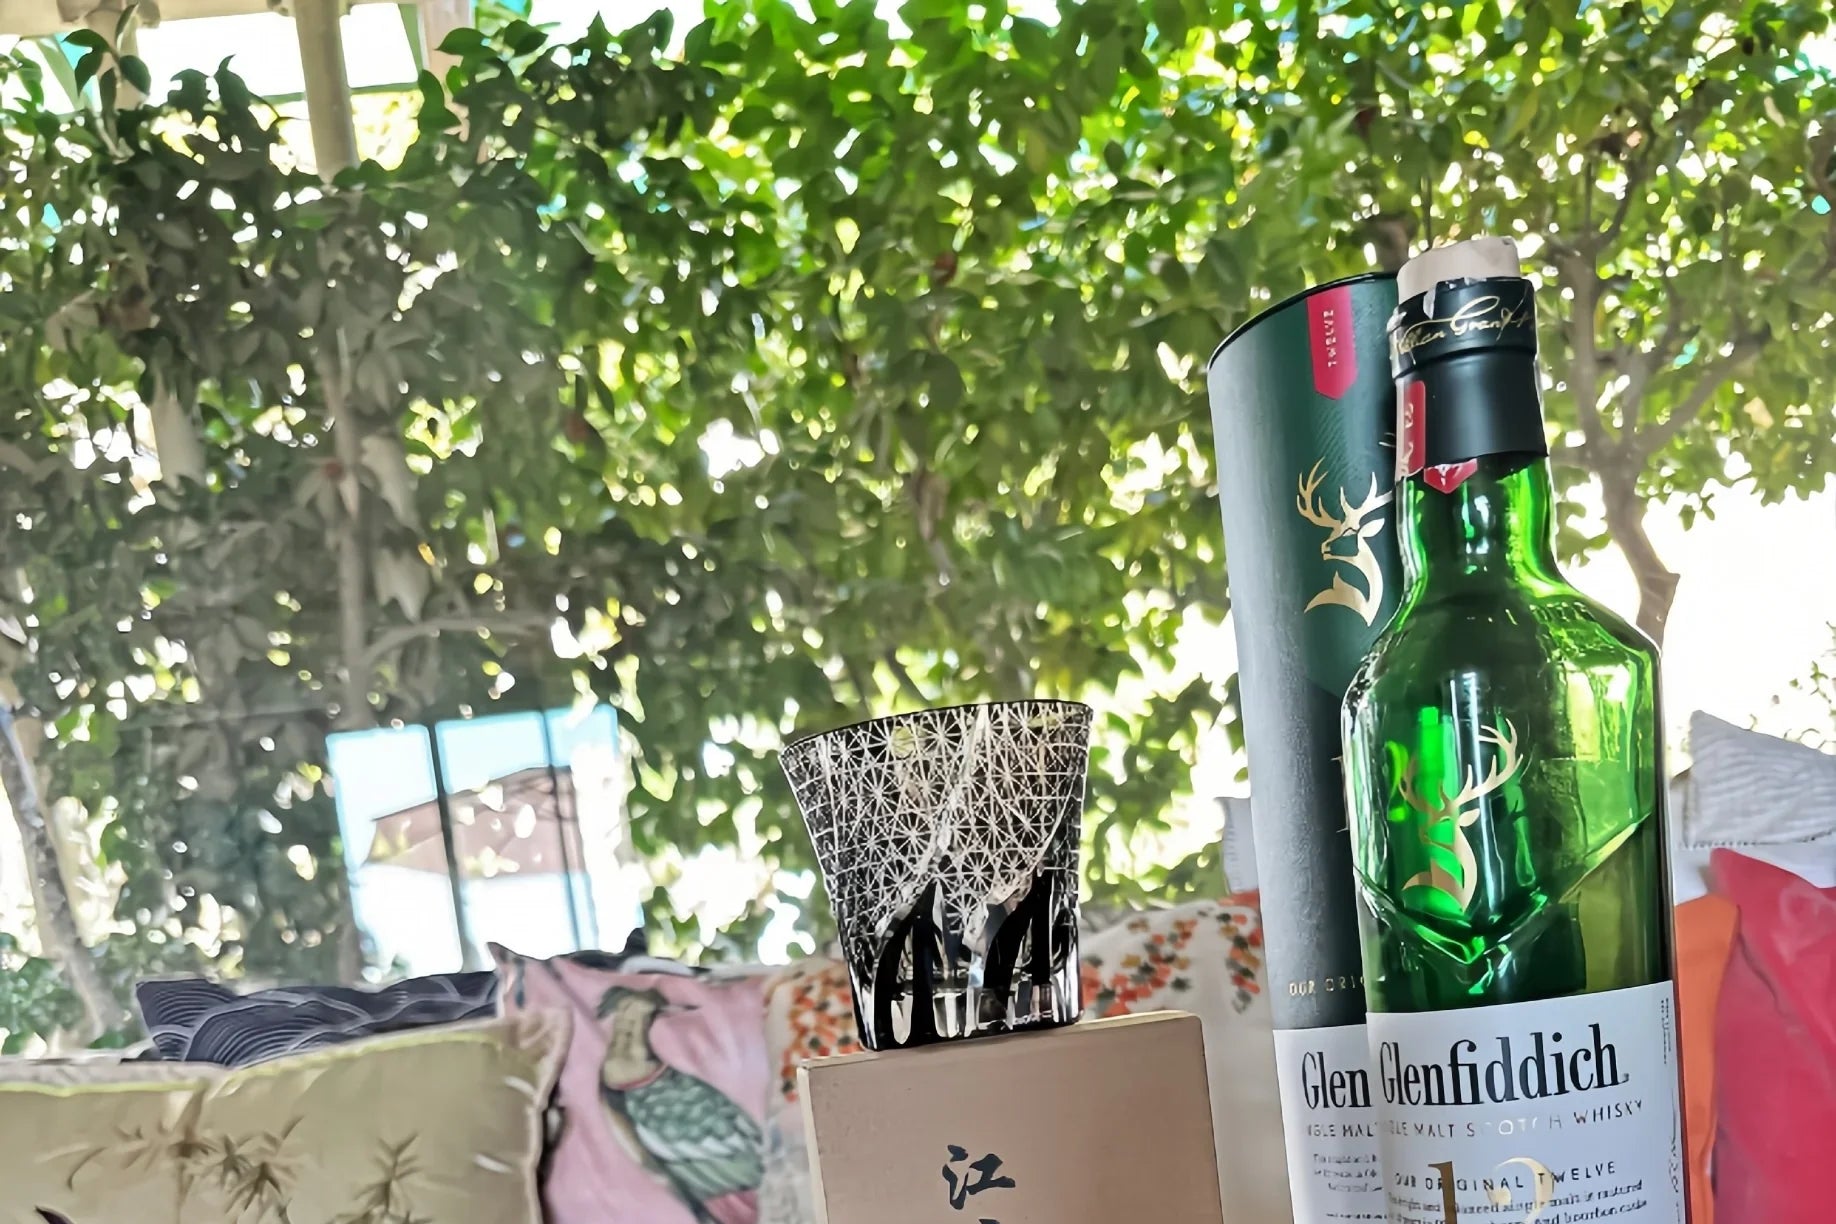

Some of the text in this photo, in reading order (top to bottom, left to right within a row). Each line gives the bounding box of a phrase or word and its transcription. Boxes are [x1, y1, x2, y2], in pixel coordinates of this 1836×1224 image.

[1323, 309, 1338, 368] TWELVE
[1288, 980, 1316, 996] OUR
[1380, 1022, 1629, 1106] Glenfiddich
[1573, 1099, 1642, 1124] WHISKY
[1538, 1160, 1616, 1184] TWELVE
